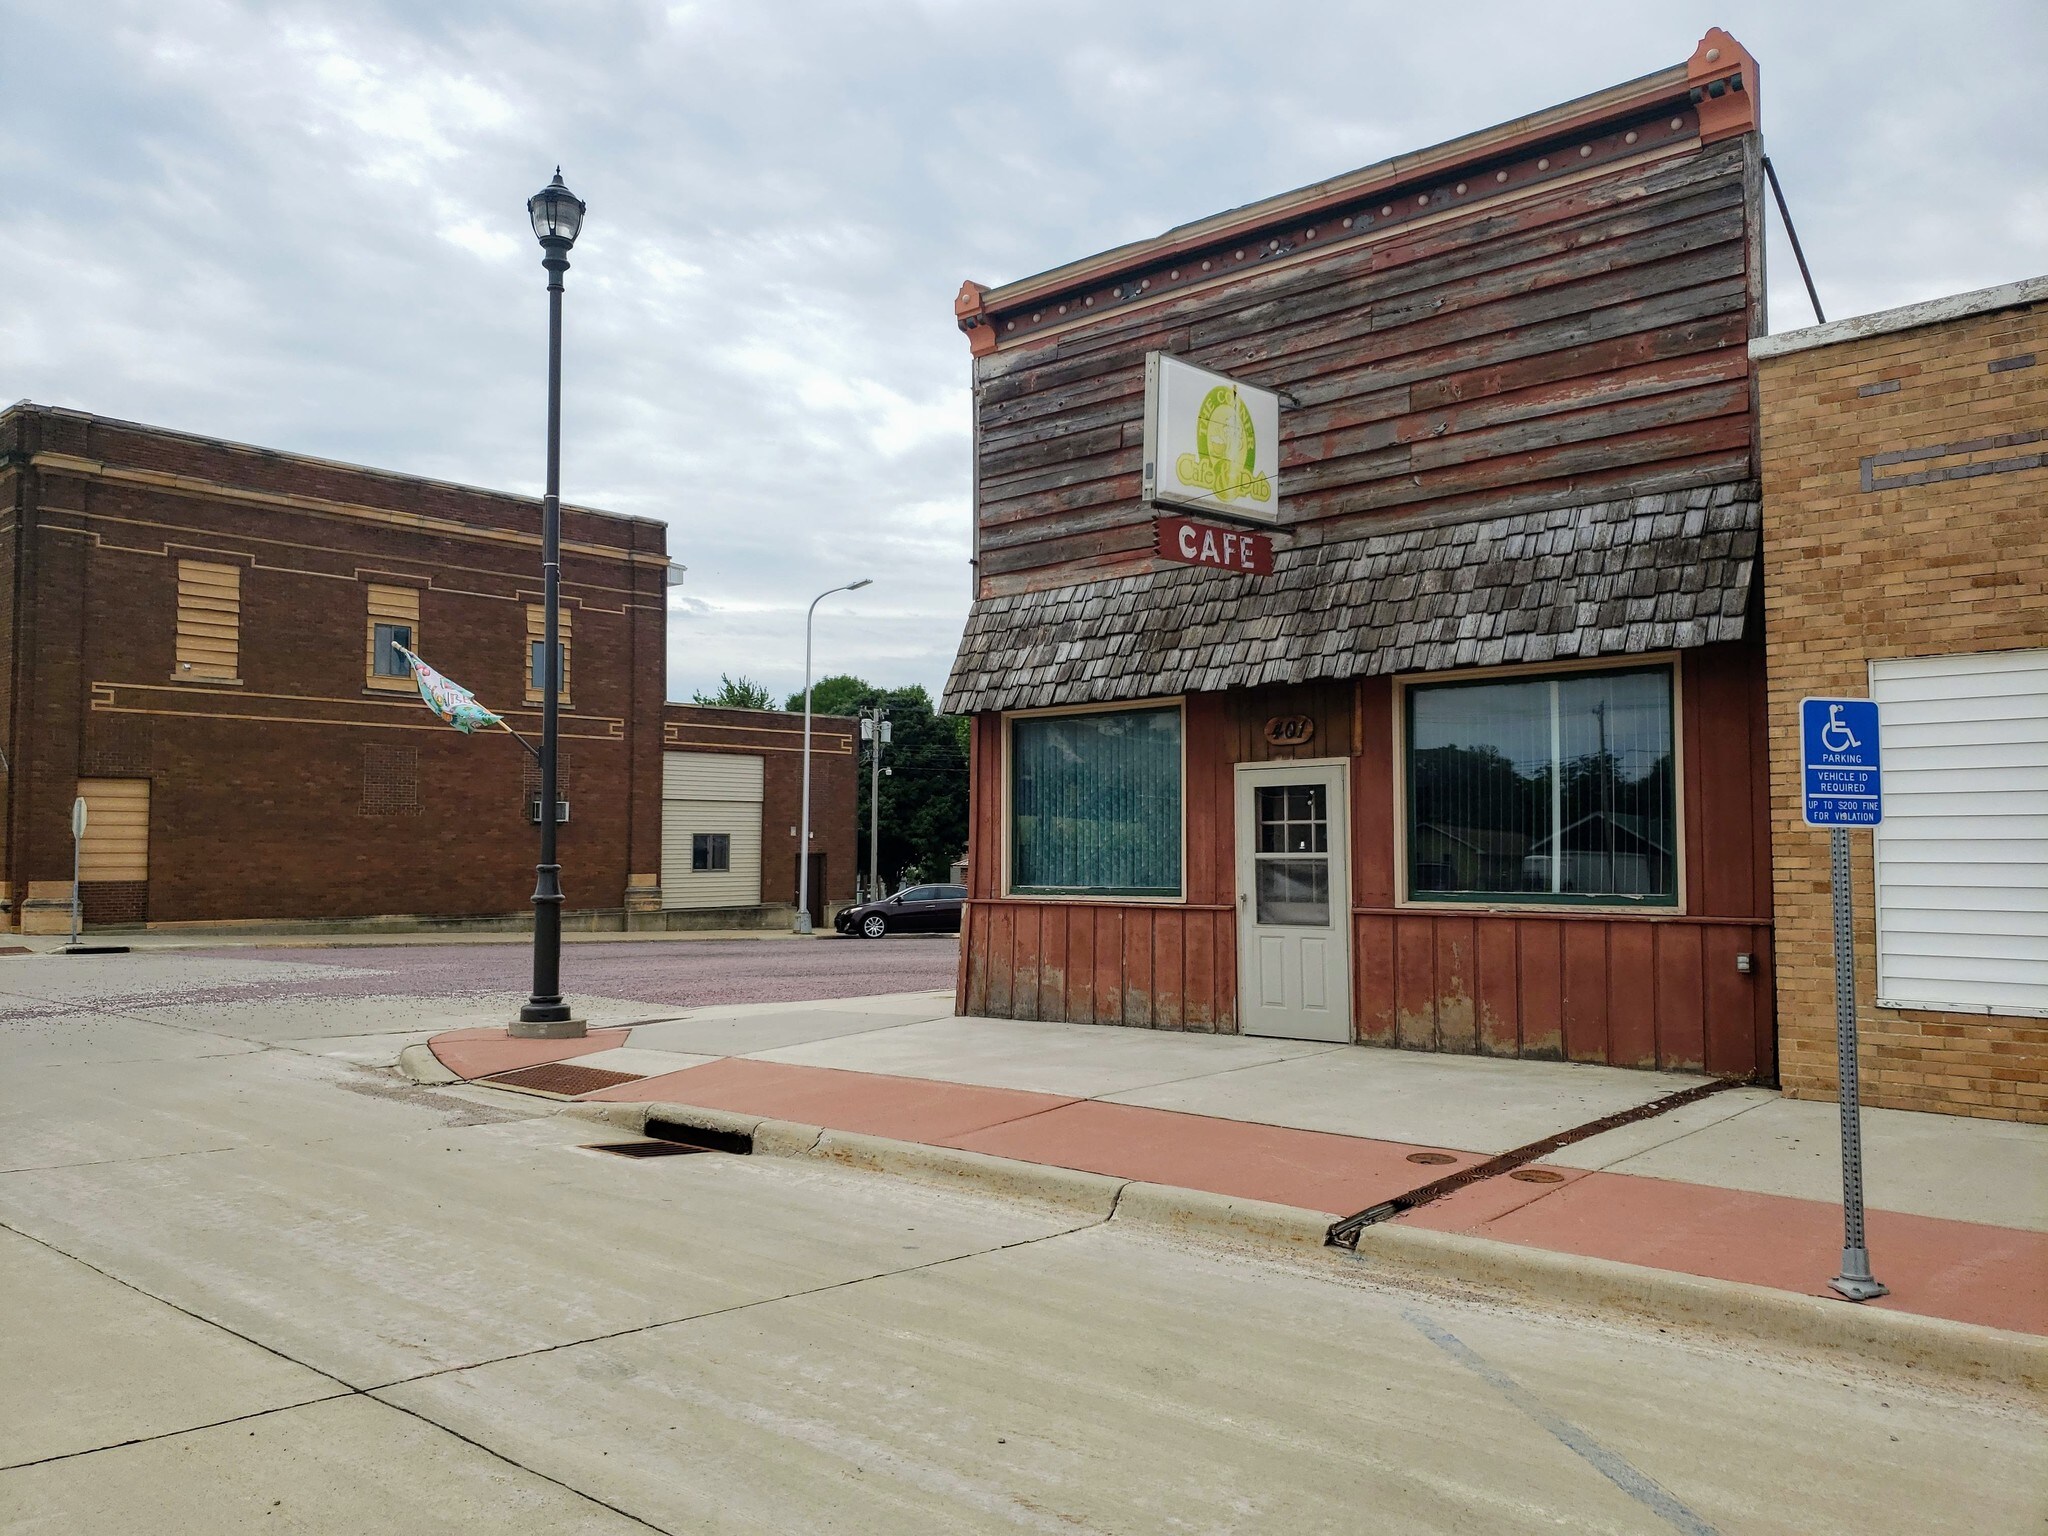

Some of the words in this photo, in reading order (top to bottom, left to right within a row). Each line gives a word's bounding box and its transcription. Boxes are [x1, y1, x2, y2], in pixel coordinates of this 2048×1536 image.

[1199, 398, 1215, 436] THE
[1217, 390, 1254, 450] CONER
[1240, 472, 1269, 497] Pub
[1271, 719, 1307, 740] 401
[1822, 753, 1862, 763] PARKING
[1817, 772, 1855, 782] VEHICLE
[1859, 773, 1869, 782] ID
[1820, 783, 1866, 792] REQUIRED
[1808, 800, 1819, 809] UP
[1823, 800, 1833, 809] TO
[1862, 802, 1879, 811] FINE
[1814, 811, 1829, 820] FOR
[1834, 812, 1874, 821] VIOLATION
